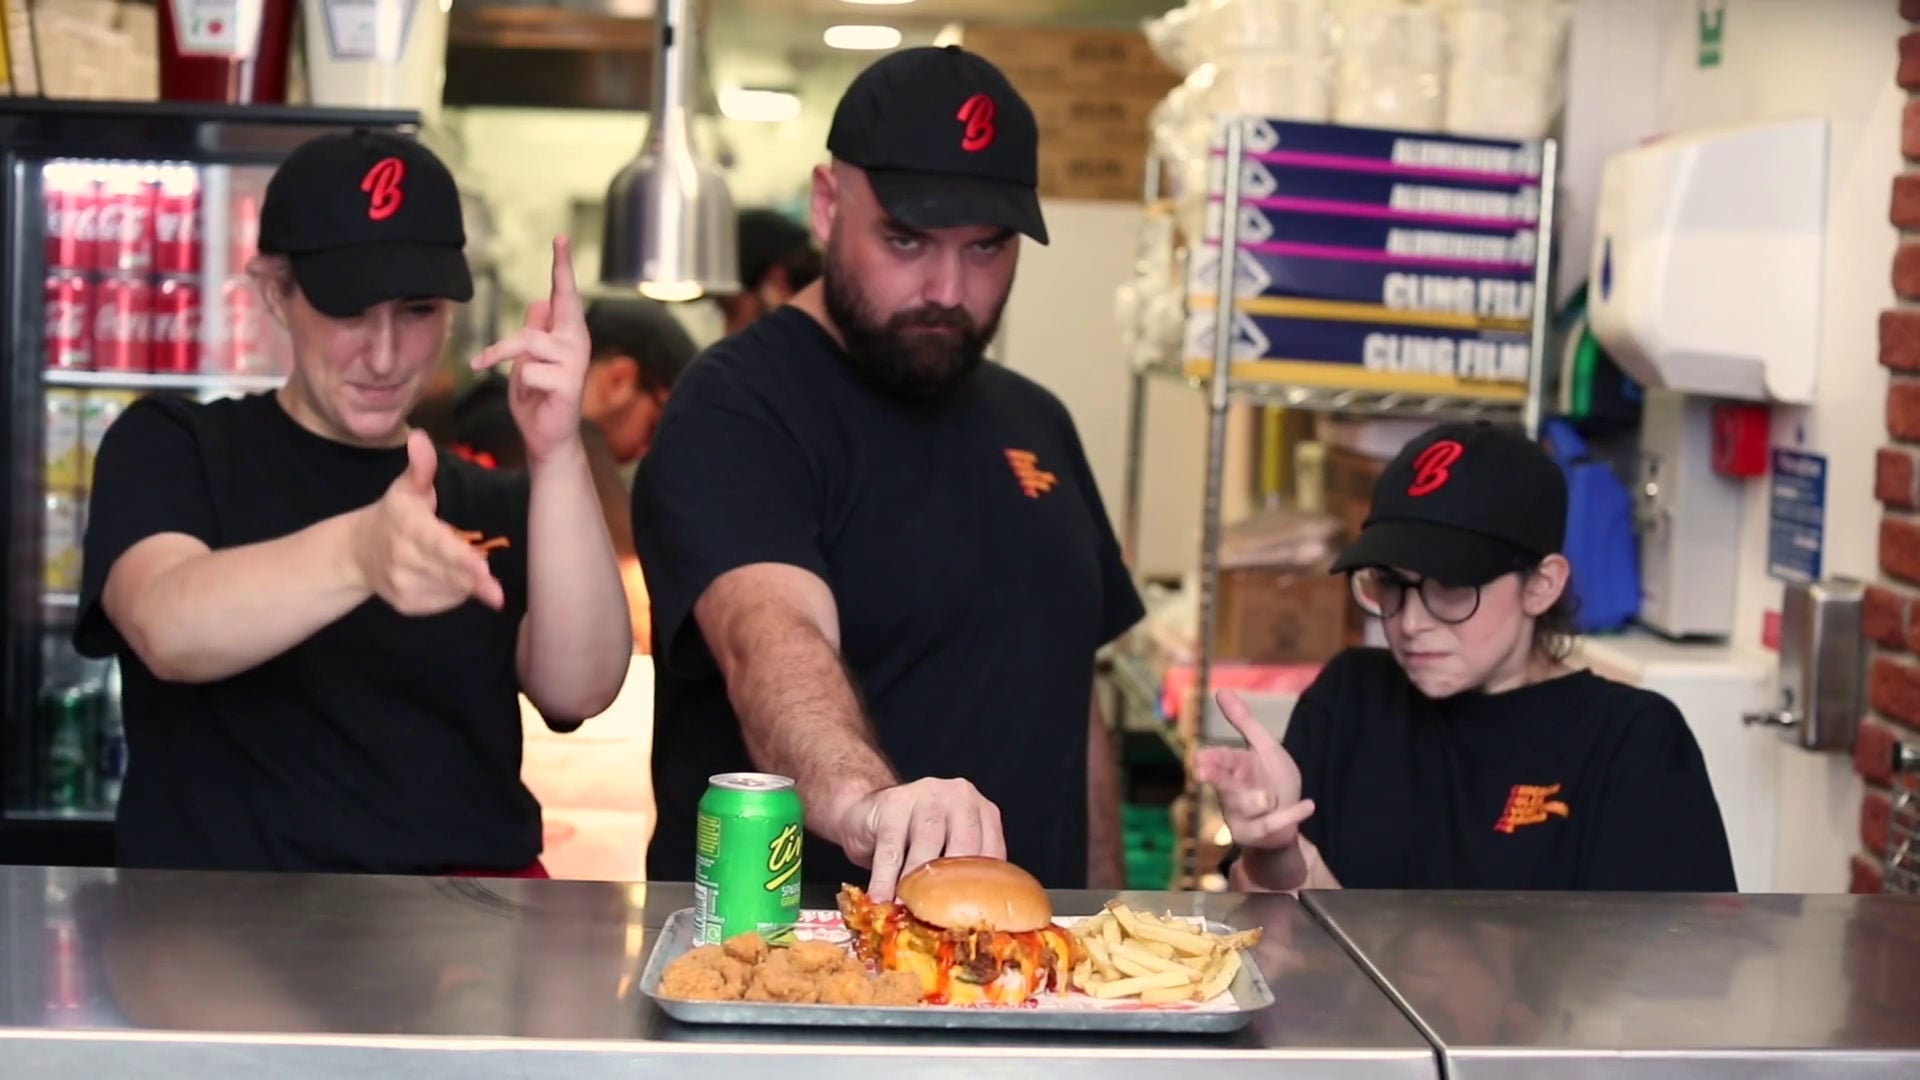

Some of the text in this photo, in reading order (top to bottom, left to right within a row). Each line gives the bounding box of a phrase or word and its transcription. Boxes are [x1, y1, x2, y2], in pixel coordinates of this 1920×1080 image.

[956, 94, 997, 153] B
[360, 157, 405, 221] B
[1382, 272, 1476, 315] CLING
[1362, 332, 1455, 374] CLING
[1408, 439, 1465, 496] B
